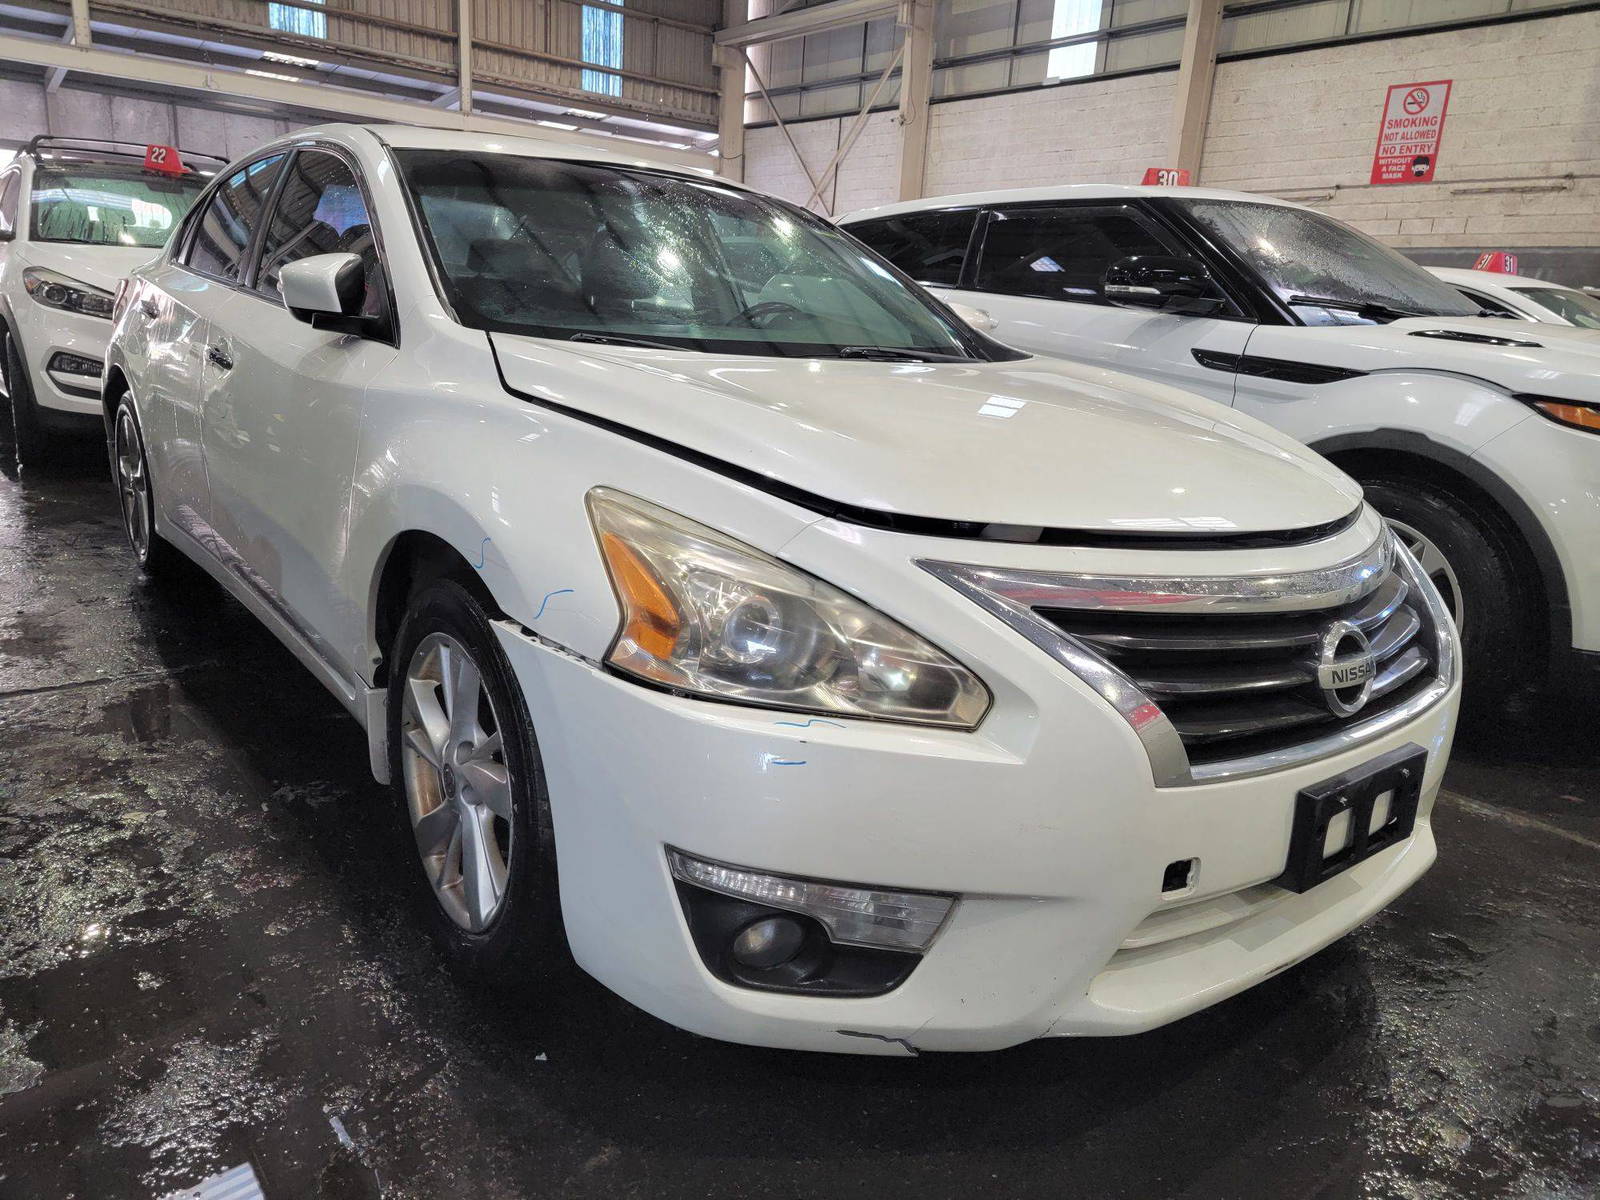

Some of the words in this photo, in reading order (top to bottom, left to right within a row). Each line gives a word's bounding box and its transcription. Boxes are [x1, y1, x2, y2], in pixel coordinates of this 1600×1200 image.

[1387, 116, 1438, 129] SMOKING
[1384, 132, 1399, 142] NOT
[1400, 130, 1437, 141] ALLOWED
[151, 147, 166, 163] 22
[1381, 145, 1396, 156] NO
[1398, 143, 1433, 154] ENTRY
[1379, 157, 1411, 165] WITHOUT
[1158, 170, 1179, 187] 30
[1477, 254, 1493, 270] 31
[1505, 255, 1513, 273] 31
